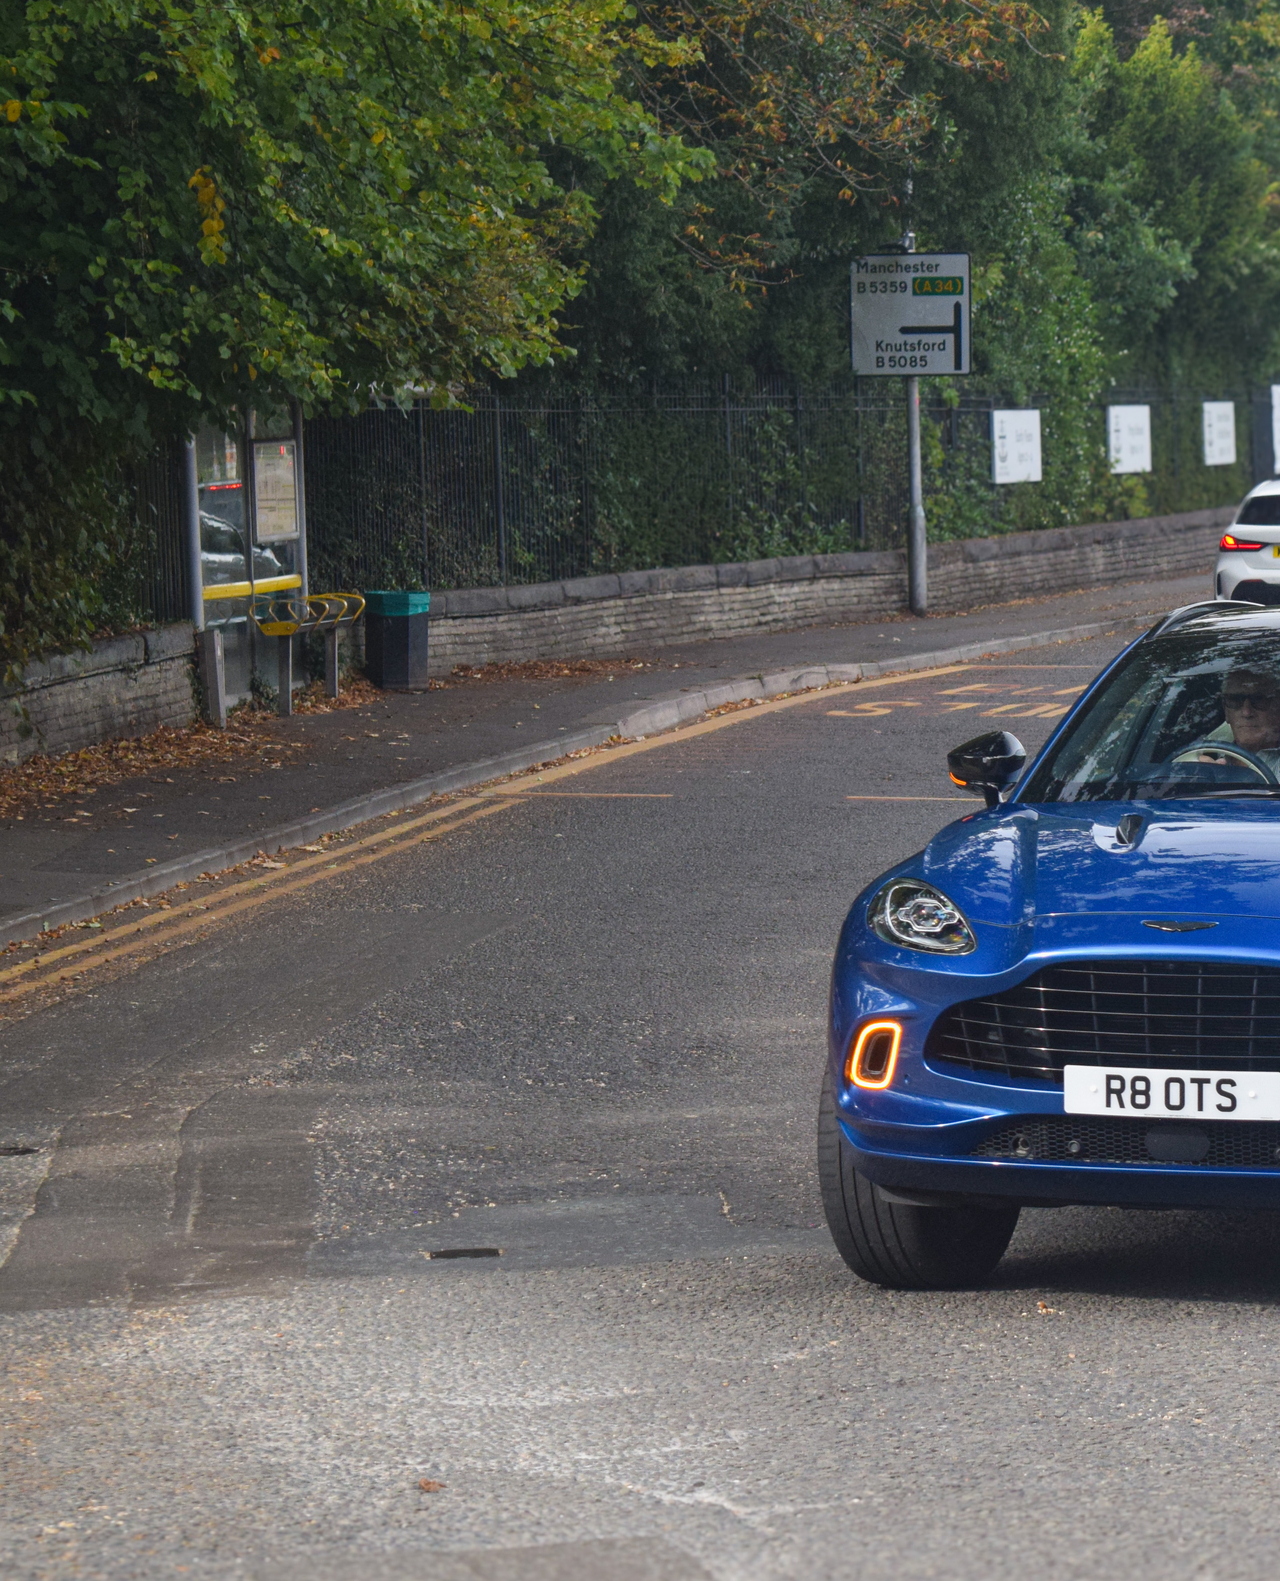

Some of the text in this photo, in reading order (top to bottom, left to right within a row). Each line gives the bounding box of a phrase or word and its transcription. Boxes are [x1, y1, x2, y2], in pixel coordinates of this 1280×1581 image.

[856, 261, 940, 274] Manchester
[875, 339, 946, 352] Knutsford
[1105, 1074, 1238, 1113] R8 OTS
